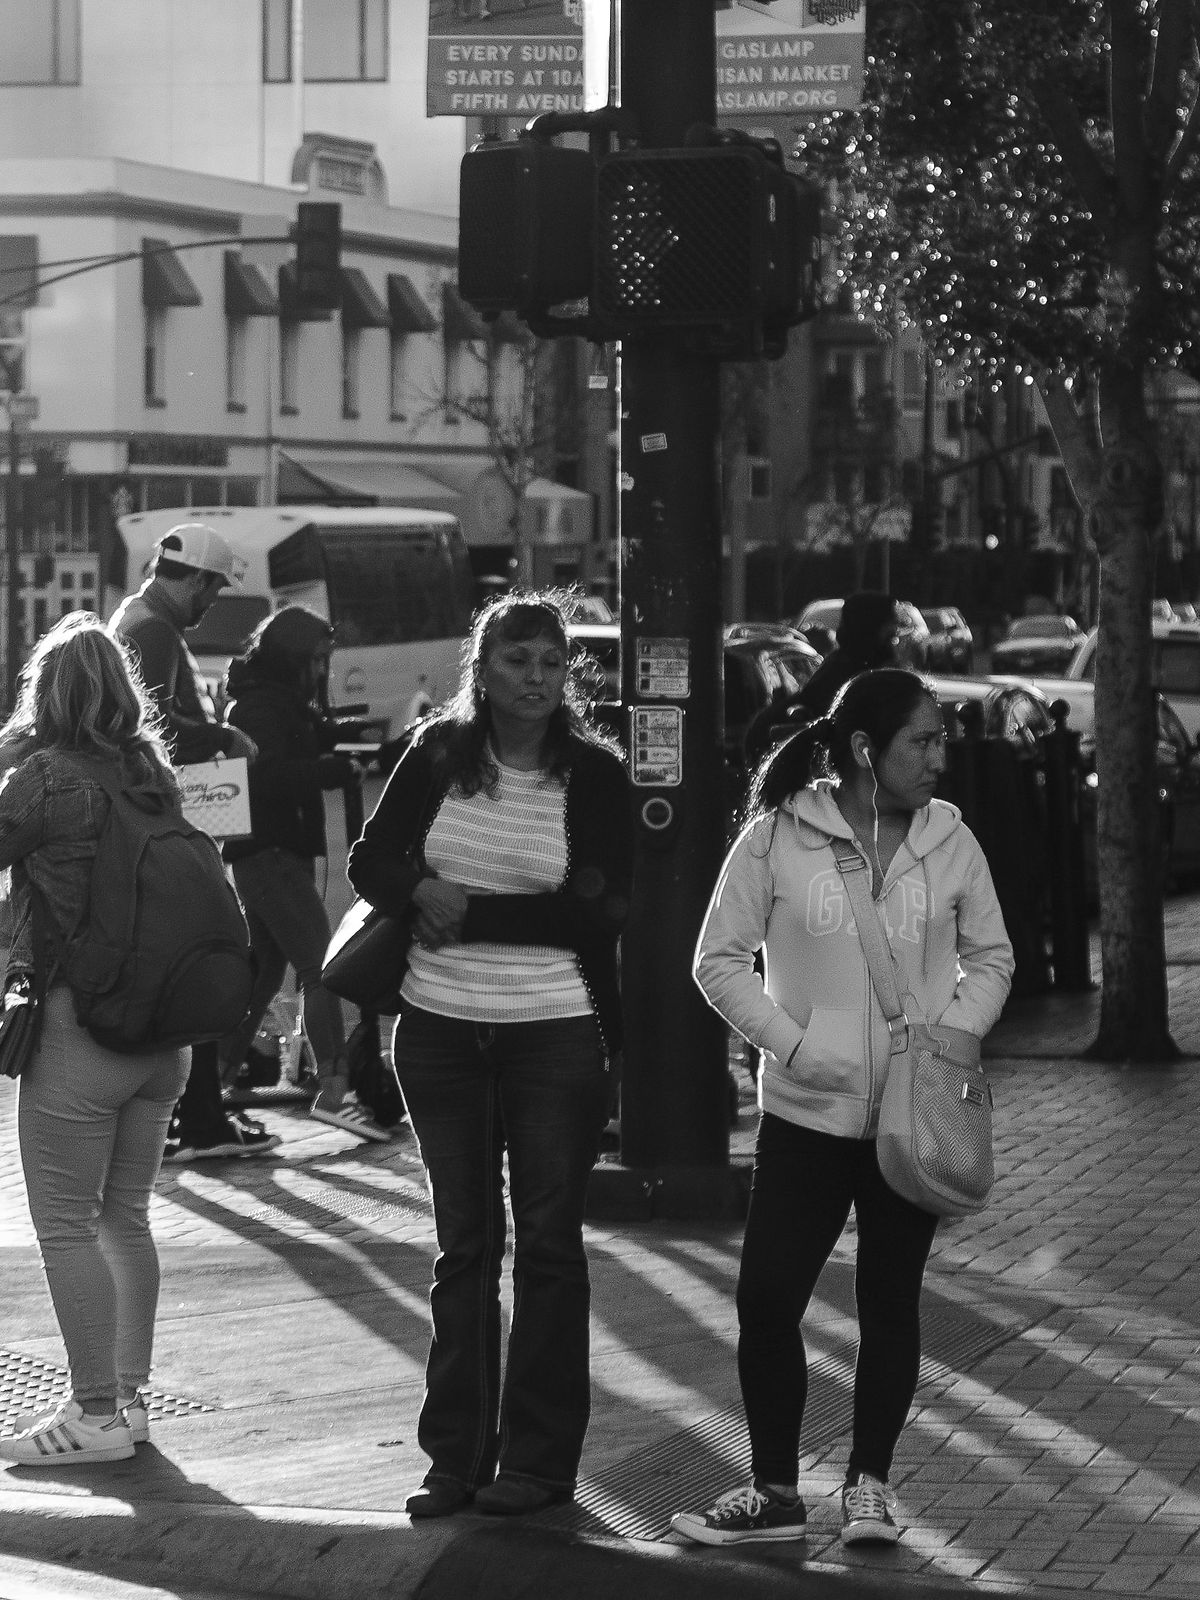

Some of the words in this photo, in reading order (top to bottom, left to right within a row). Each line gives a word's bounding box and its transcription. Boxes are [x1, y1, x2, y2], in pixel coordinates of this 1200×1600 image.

[448, 45, 513, 61] EVERY
[521, 45, 584, 61] SUND
[722, 41, 815, 59] GASLAMP
[446, 69, 515, 86] STARTS
[522, 69, 545, 86] AT
[771, 64, 852, 82] MARKET
[451, 93, 509, 109] FIFTH
